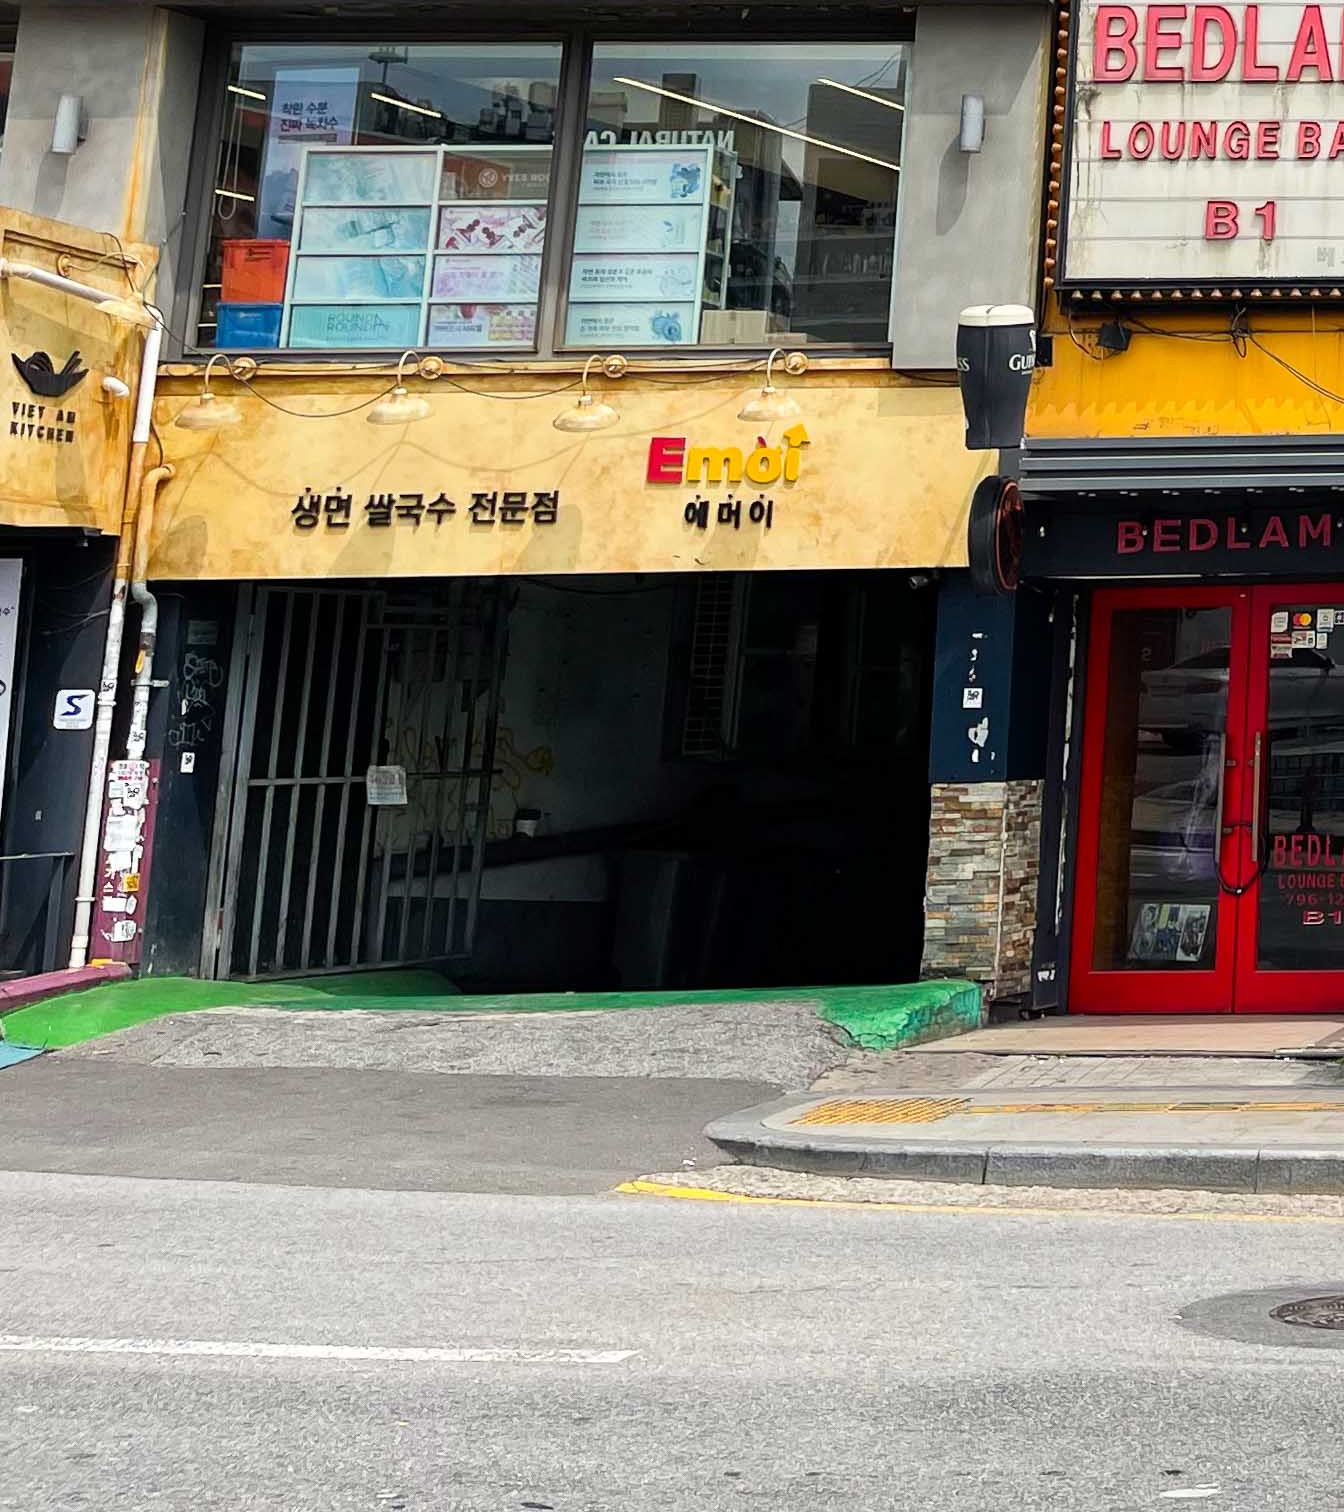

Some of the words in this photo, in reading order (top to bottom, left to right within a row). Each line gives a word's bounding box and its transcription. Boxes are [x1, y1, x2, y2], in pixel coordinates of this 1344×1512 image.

[1100, 120, 1280, 160] LOUNGE
[1204, 200, 1278, 241] B1
[12, 401, 46, 420] VIET
[10, 420, 74, 443] KITCHEN
[364, 491, 457, 527] 쌀국수
[468, 489, 560, 525] 전문점
[1116, 513, 1334, 555] BEDLAM
[1277, 873, 1336, 890] LOUNGE
[1303, 909, 1343, 926] B1
